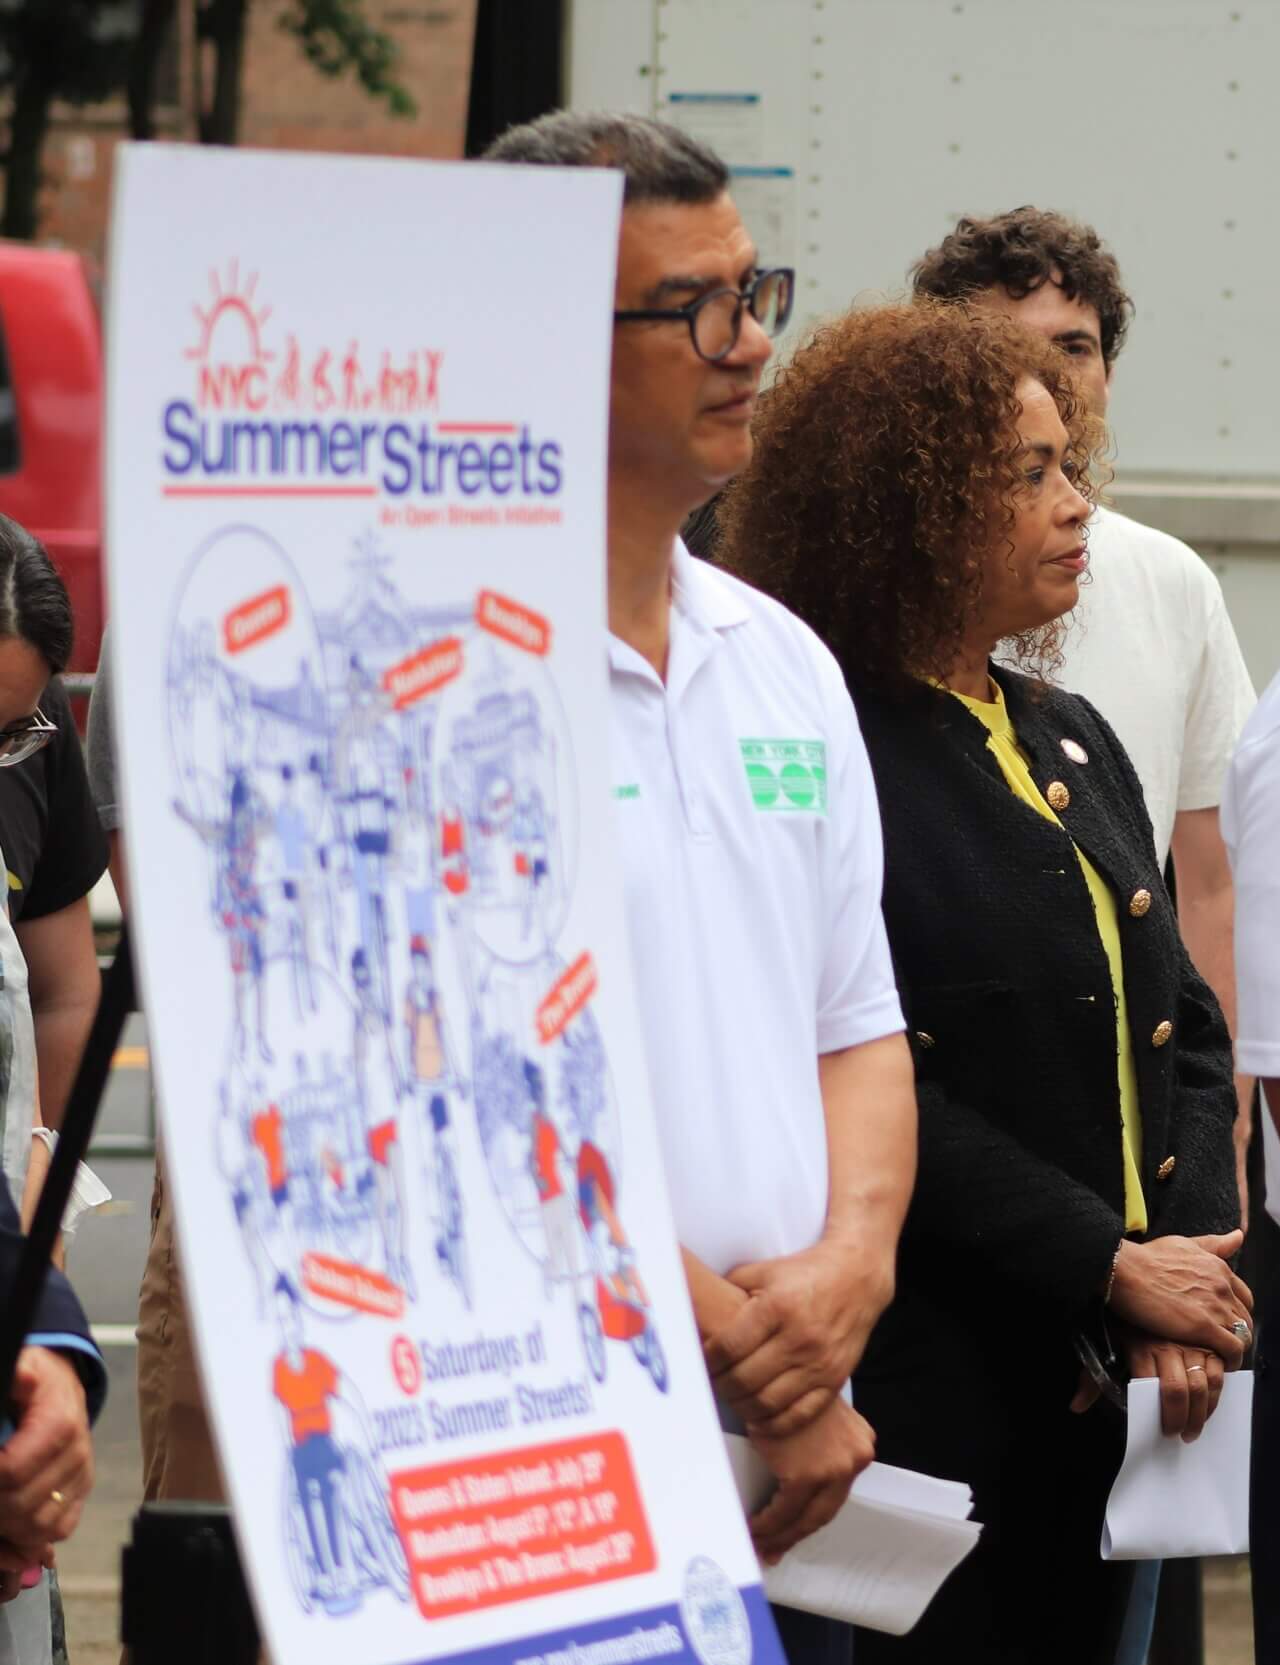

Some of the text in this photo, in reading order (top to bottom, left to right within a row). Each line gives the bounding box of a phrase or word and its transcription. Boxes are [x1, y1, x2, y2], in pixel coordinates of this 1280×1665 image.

[200, 364, 268, 411] NYC
[419, 1337, 522, 1382] Saturdays
[525, 1320, 547, 1364] of
[373, 1402, 426, 1450] 2023
[426, 1396, 512, 1440] Summer
